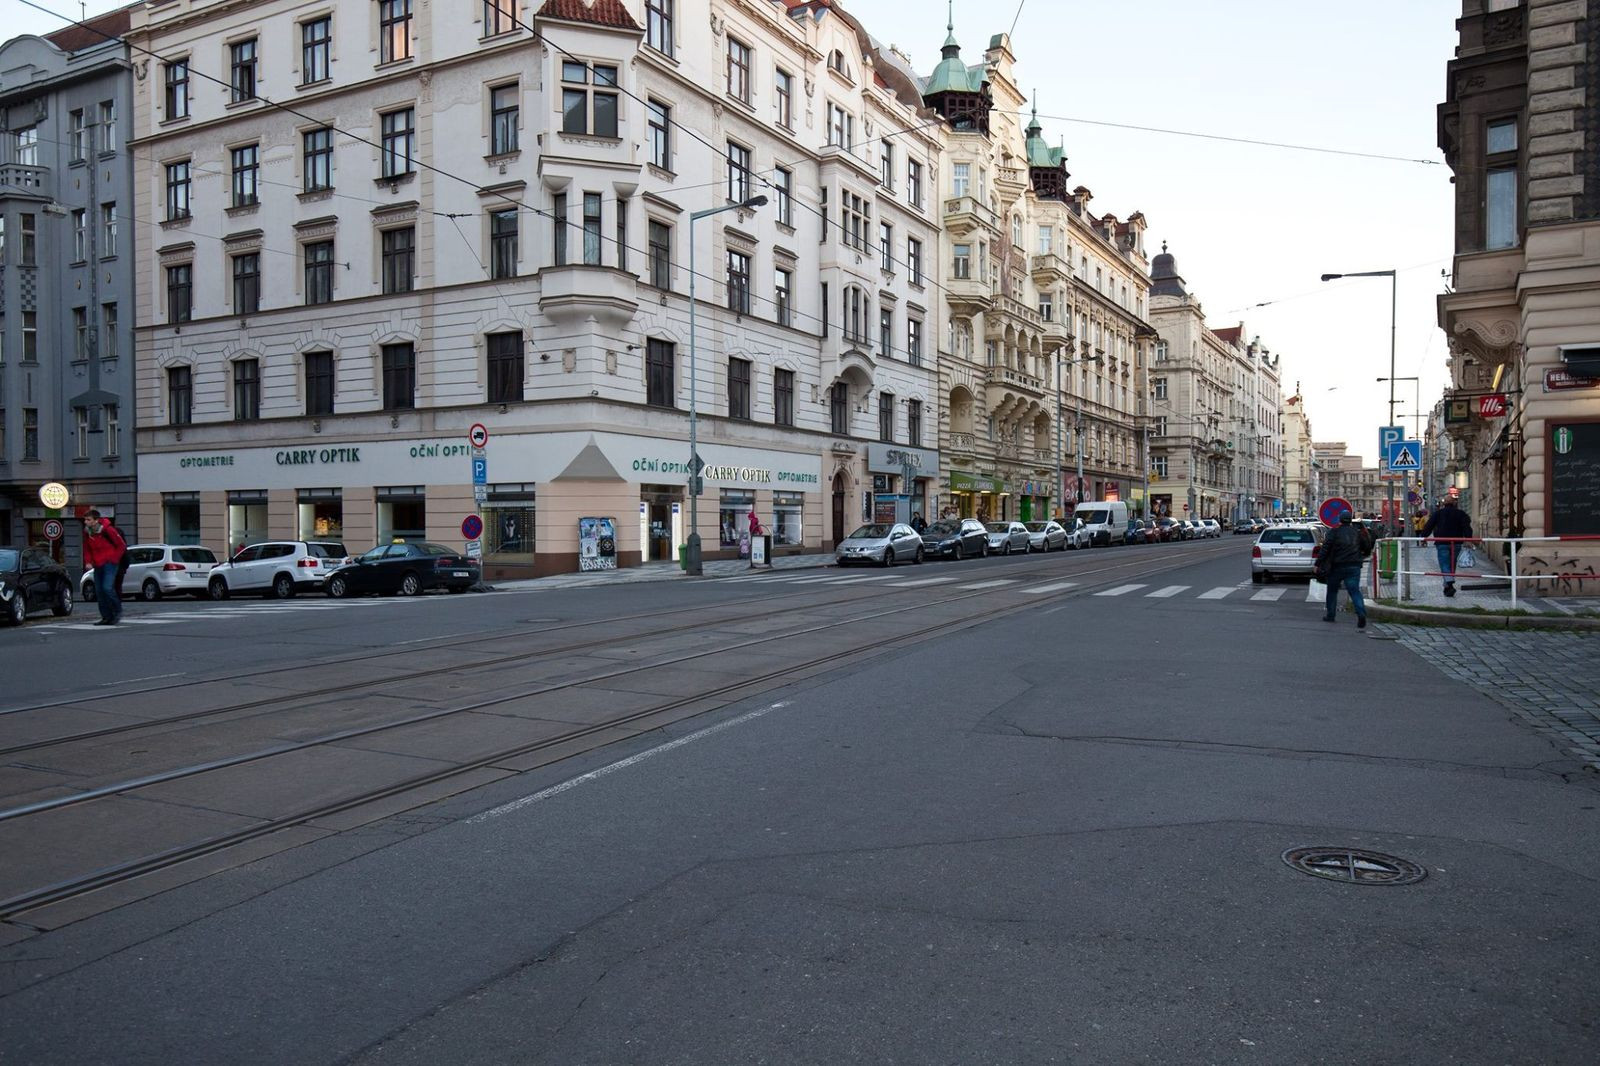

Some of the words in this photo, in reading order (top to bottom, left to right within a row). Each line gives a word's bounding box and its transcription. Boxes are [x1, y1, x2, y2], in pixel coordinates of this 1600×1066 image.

[1481, 398, 1502, 414] illy
[1384, 430, 1399, 449] P
[276, 449, 316, 465] CARRY
[320, 447, 360, 463] OPTIK
[410, 444, 439, 457] OČNÍ
[180, 455, 234, 468] OPTOMETRIE
[632, 457, 659, 472] OČNÍ
[475, 462, 484, 477] P
[704, 464, 739, 481] CARRY
[742, 466, 771, 483] OPTIK
[778, 471, 817, 483] OPTOMETRIE
[48, 525, 59, 535] 30
